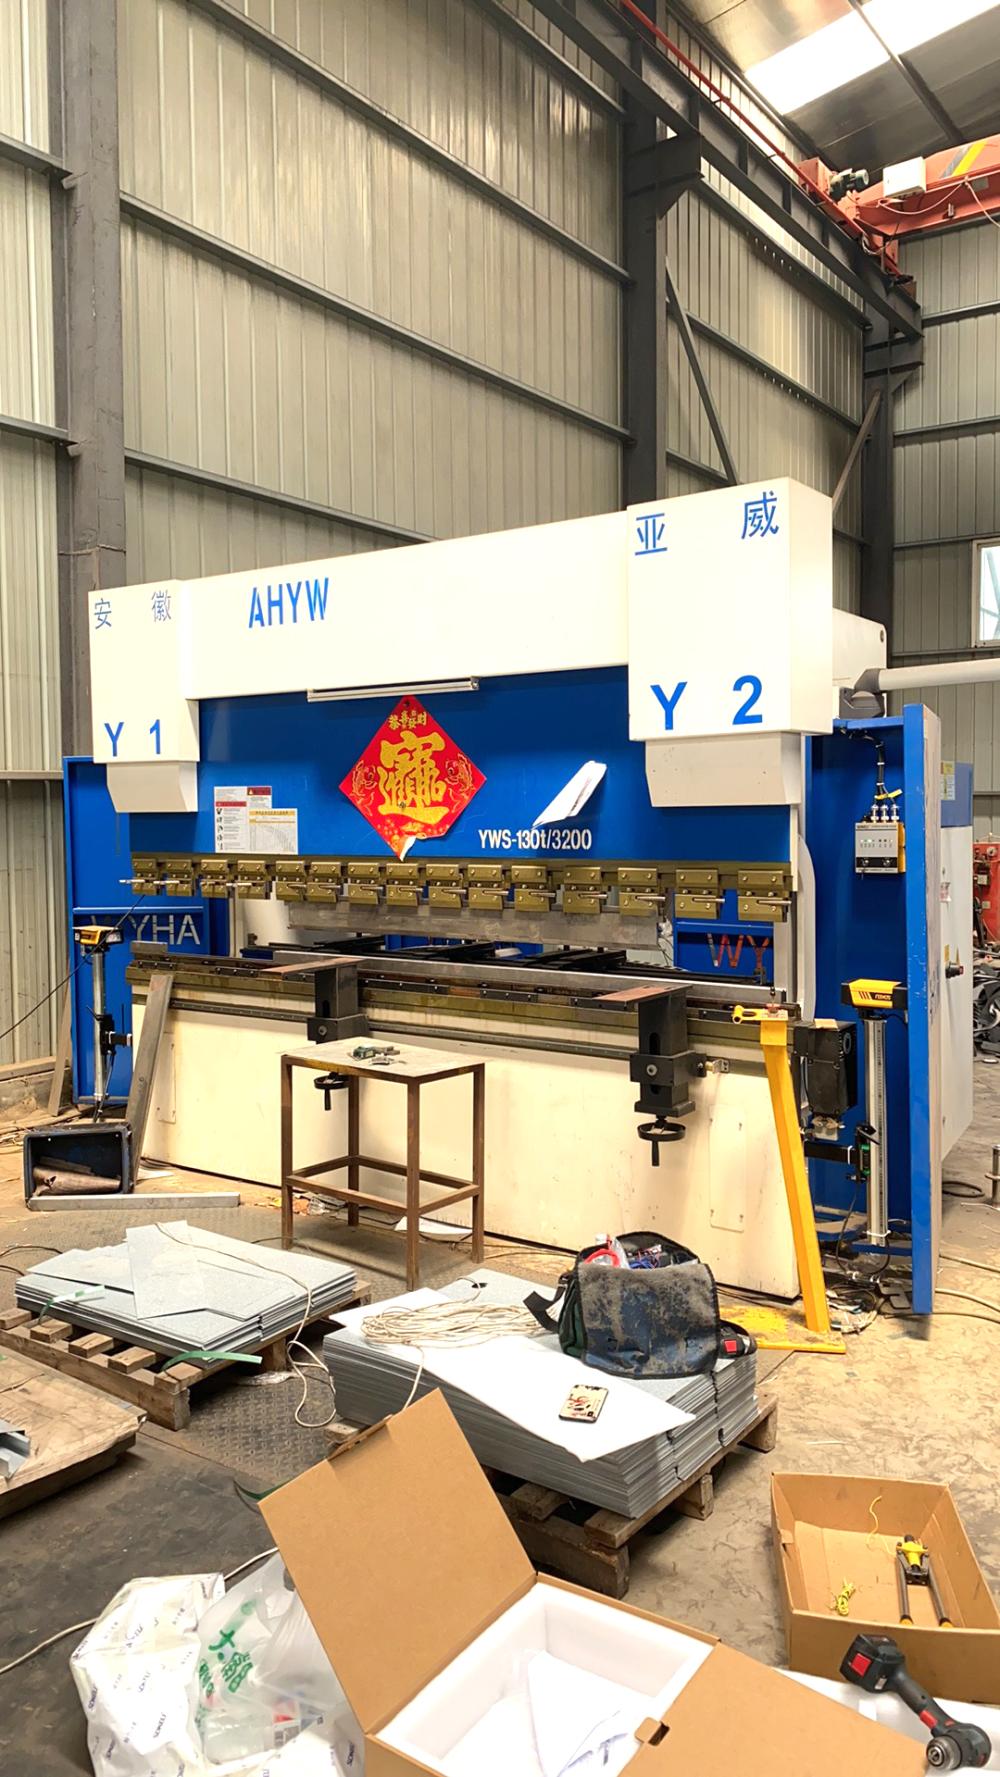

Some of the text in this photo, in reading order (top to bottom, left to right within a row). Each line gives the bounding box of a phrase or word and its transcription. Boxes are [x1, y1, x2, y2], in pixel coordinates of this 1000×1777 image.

[633, 490, 780, 556] 亚 威
[150, 590, 173, 623] 徽
[248, 576, 330, 629] AHYW
[649, 674, 765, 732] Y 2
[104, 719, 162, 758] Y 1
[478, 829, 592, 850] YWS-130t/3200
